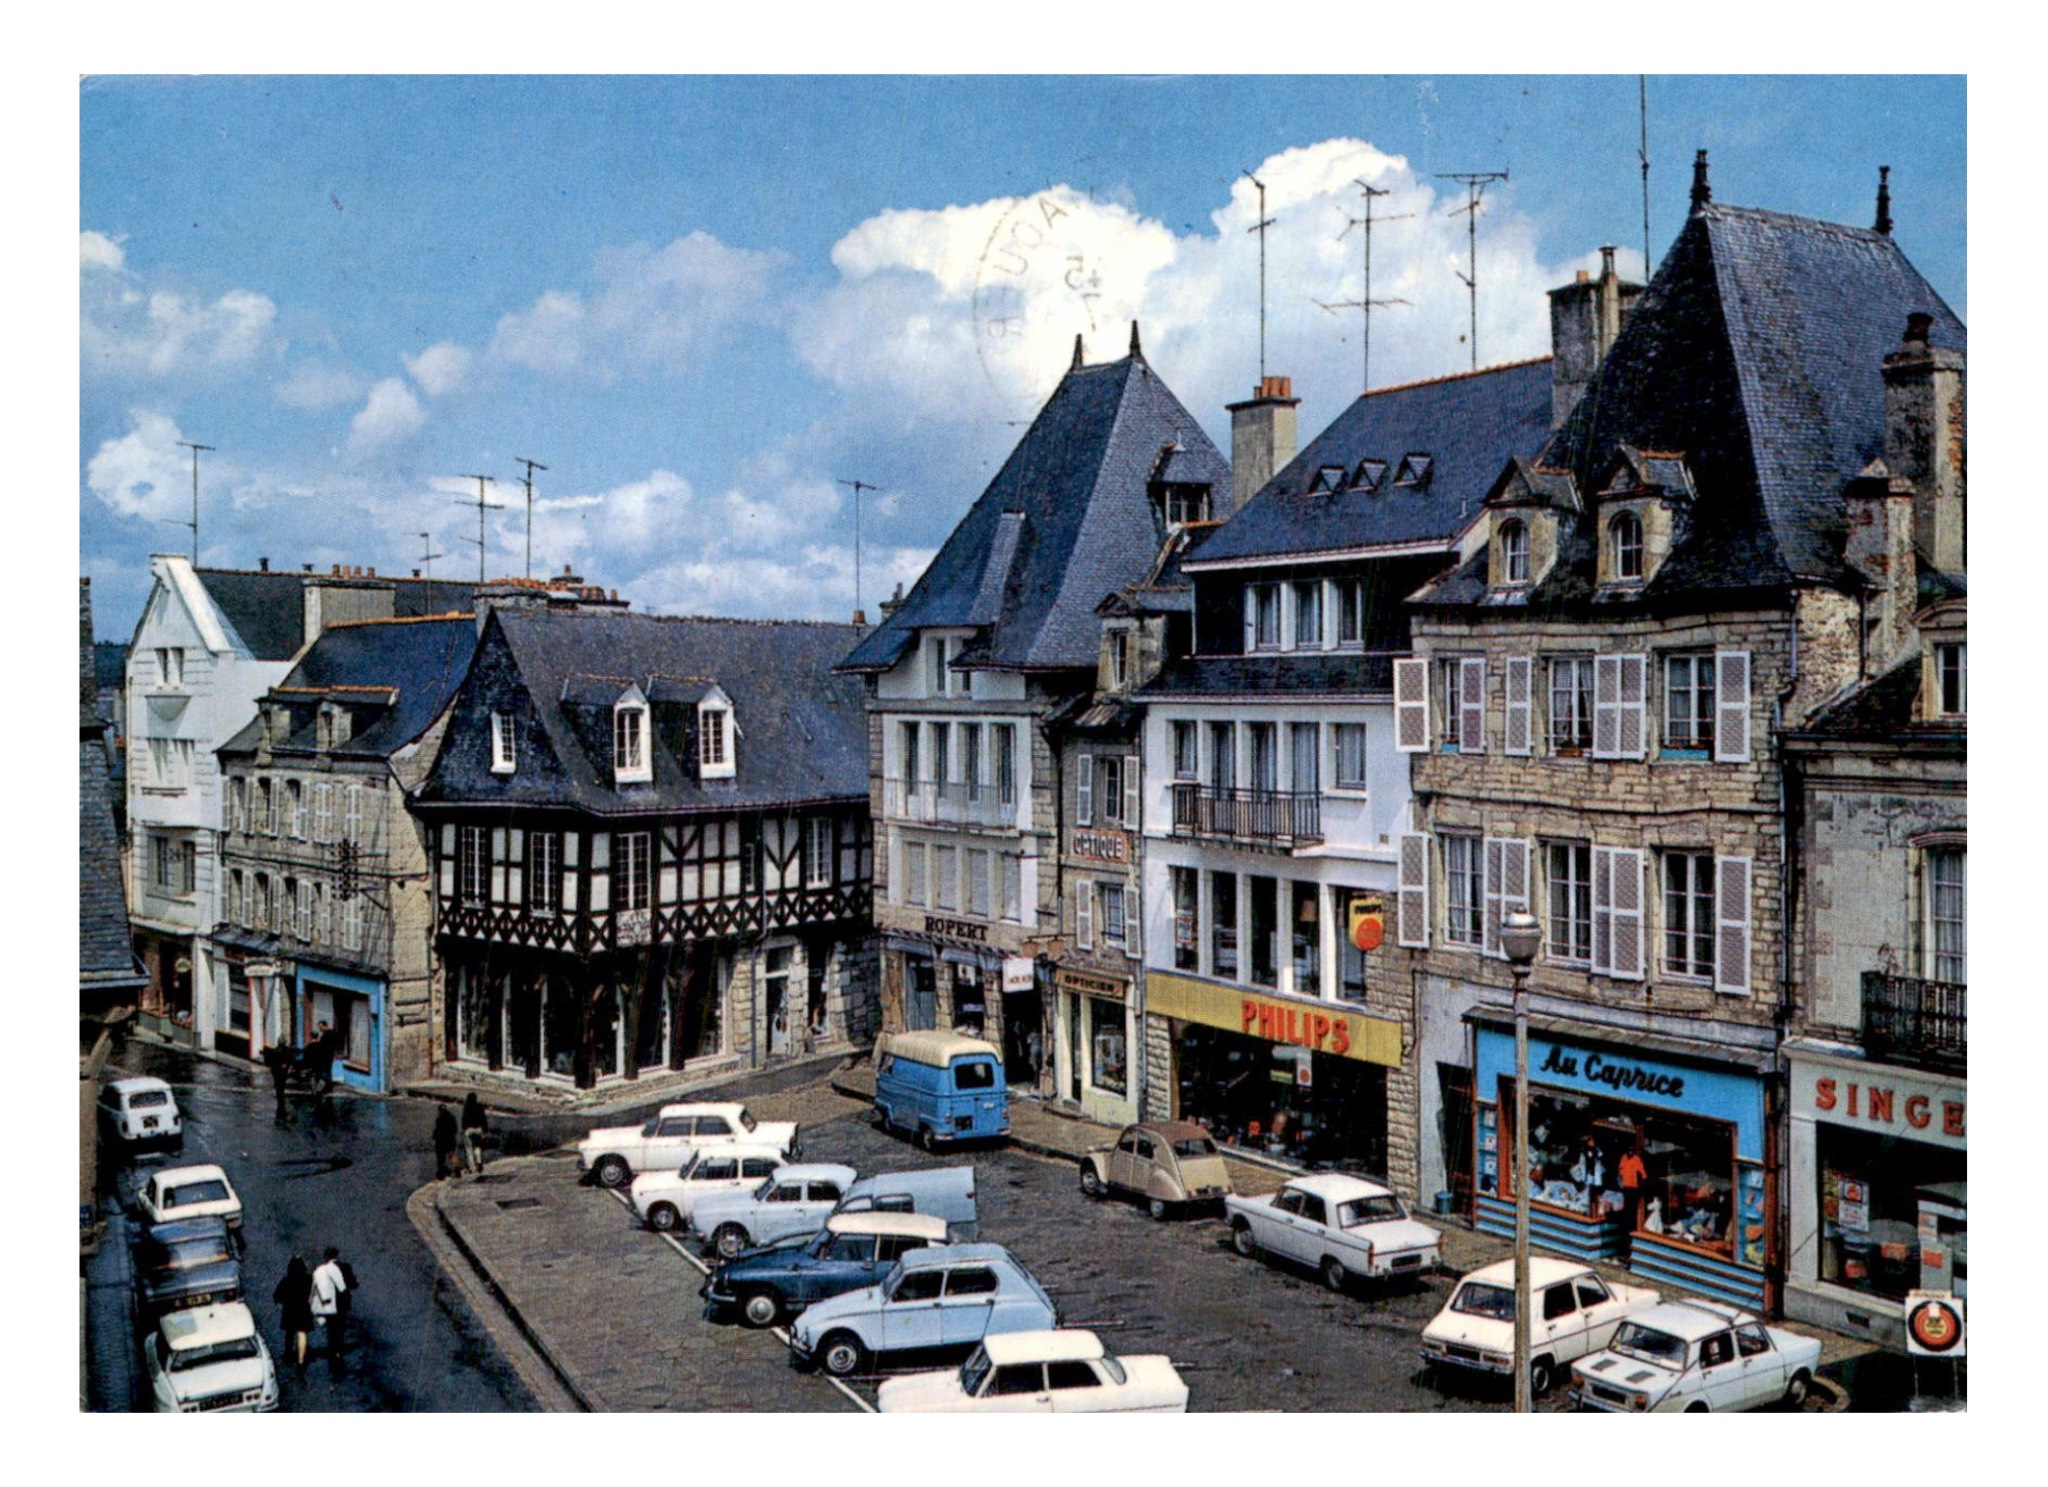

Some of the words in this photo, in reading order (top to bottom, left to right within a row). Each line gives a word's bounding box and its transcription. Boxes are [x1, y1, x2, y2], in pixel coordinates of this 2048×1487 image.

[1073, 833, 1122, 859] OPTIQUE
[924, 915, 988, 941] ROPERT
[1064, 974, 1115, 992] OPTICIEN
[1241, 999, 1351, 1055] PHILIPS
[1540, 1046, 1579, 1077] Au
[1584, 1054, 1685, 1098] Caprice
[1815, 1076, 1965, 1137] SINGE
